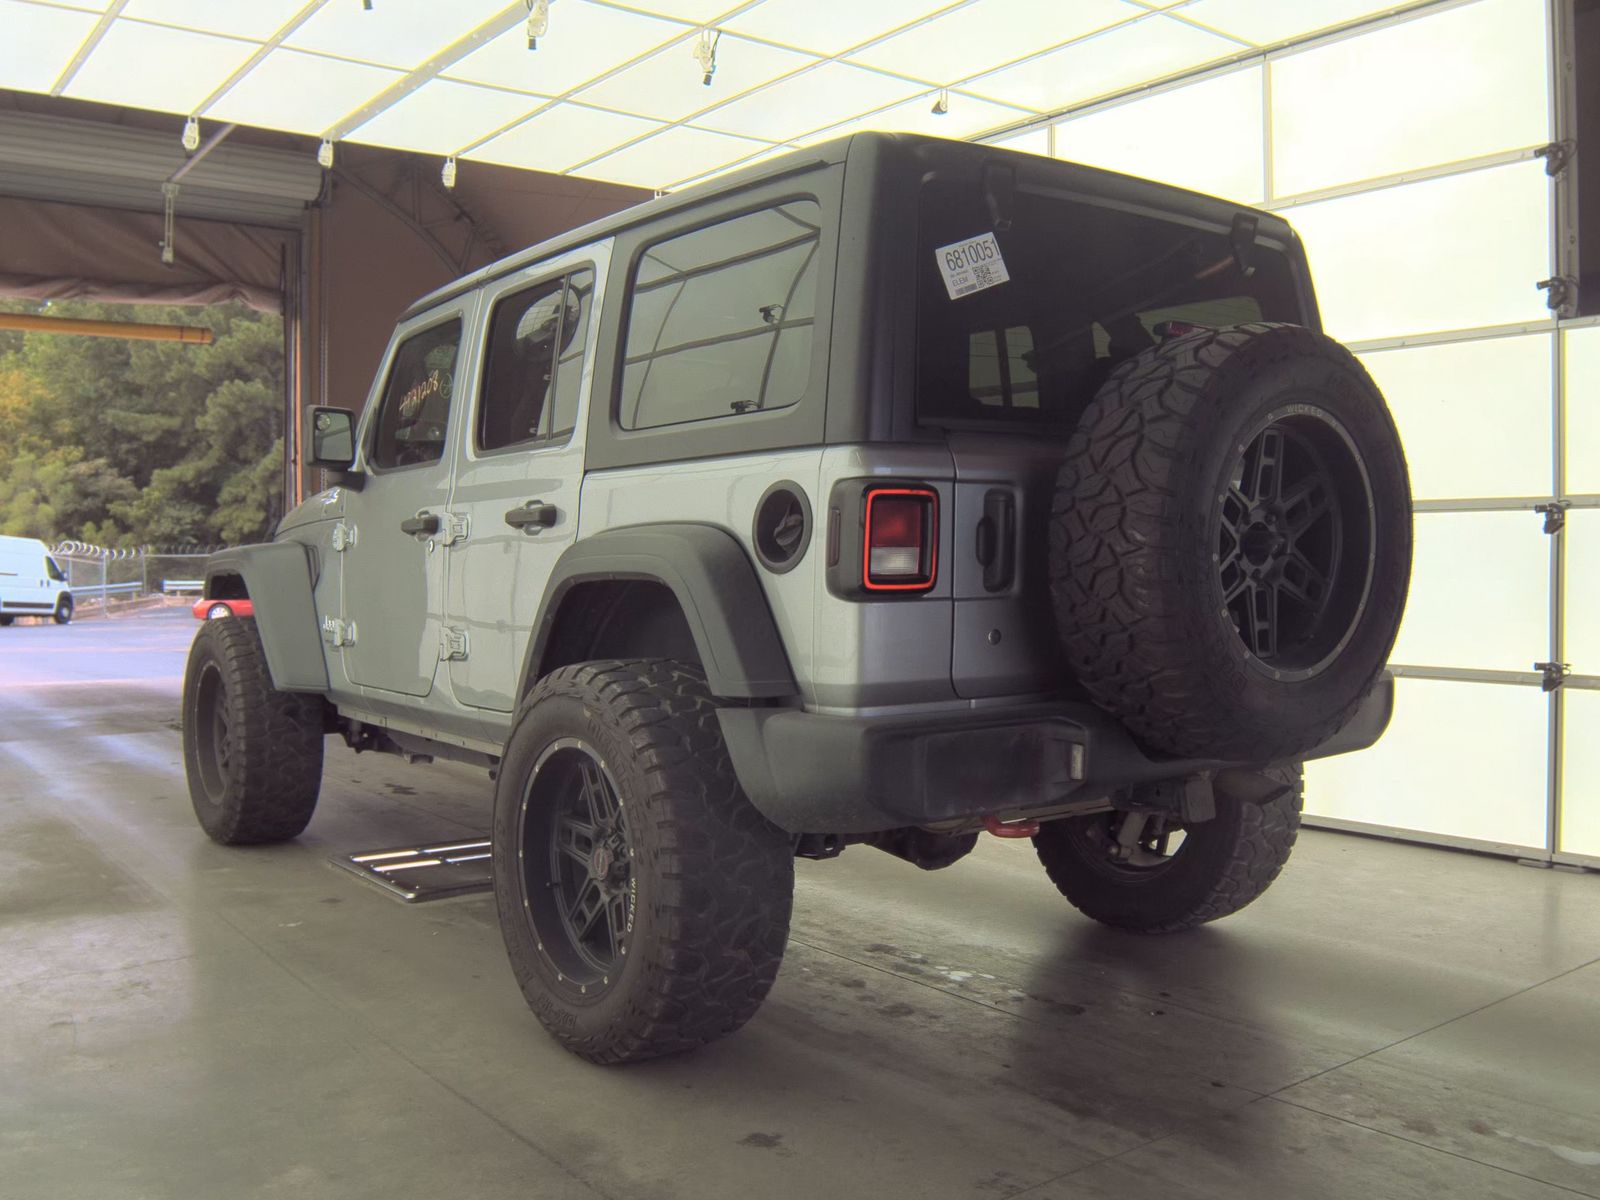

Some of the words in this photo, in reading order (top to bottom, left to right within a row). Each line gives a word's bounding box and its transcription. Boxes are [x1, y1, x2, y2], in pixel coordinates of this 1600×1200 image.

[945, 238, 1000, 271] 6810051
[1287, 403, 1323, 417] WICKED
[626, 877, 636, 933] WICKED
